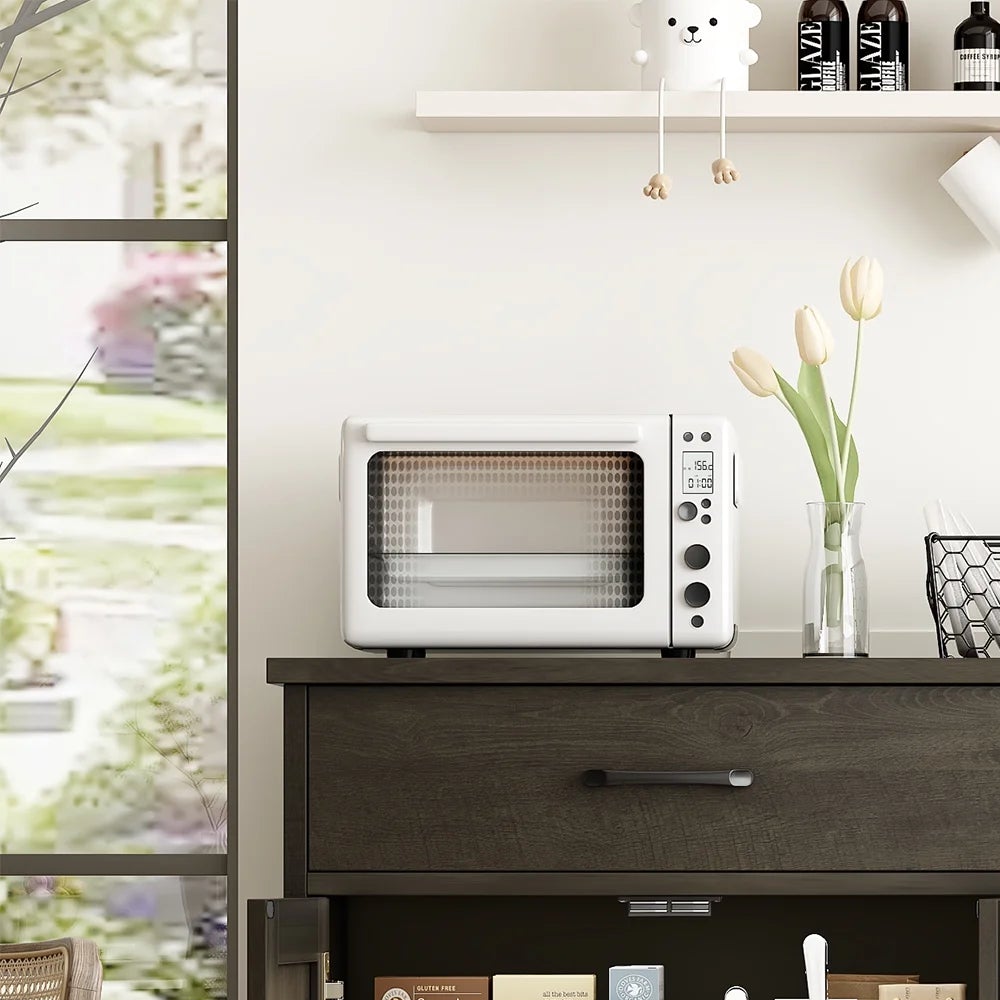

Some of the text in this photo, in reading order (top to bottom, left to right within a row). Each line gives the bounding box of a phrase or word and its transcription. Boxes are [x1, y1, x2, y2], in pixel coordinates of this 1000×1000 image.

[800, 21, 822, 91] GLAZE
[822, 61, 836, 91] RUFFLE
[859, 21, 882, 91] GLAZE
[881, 61, 896, 91] RUFFLE
